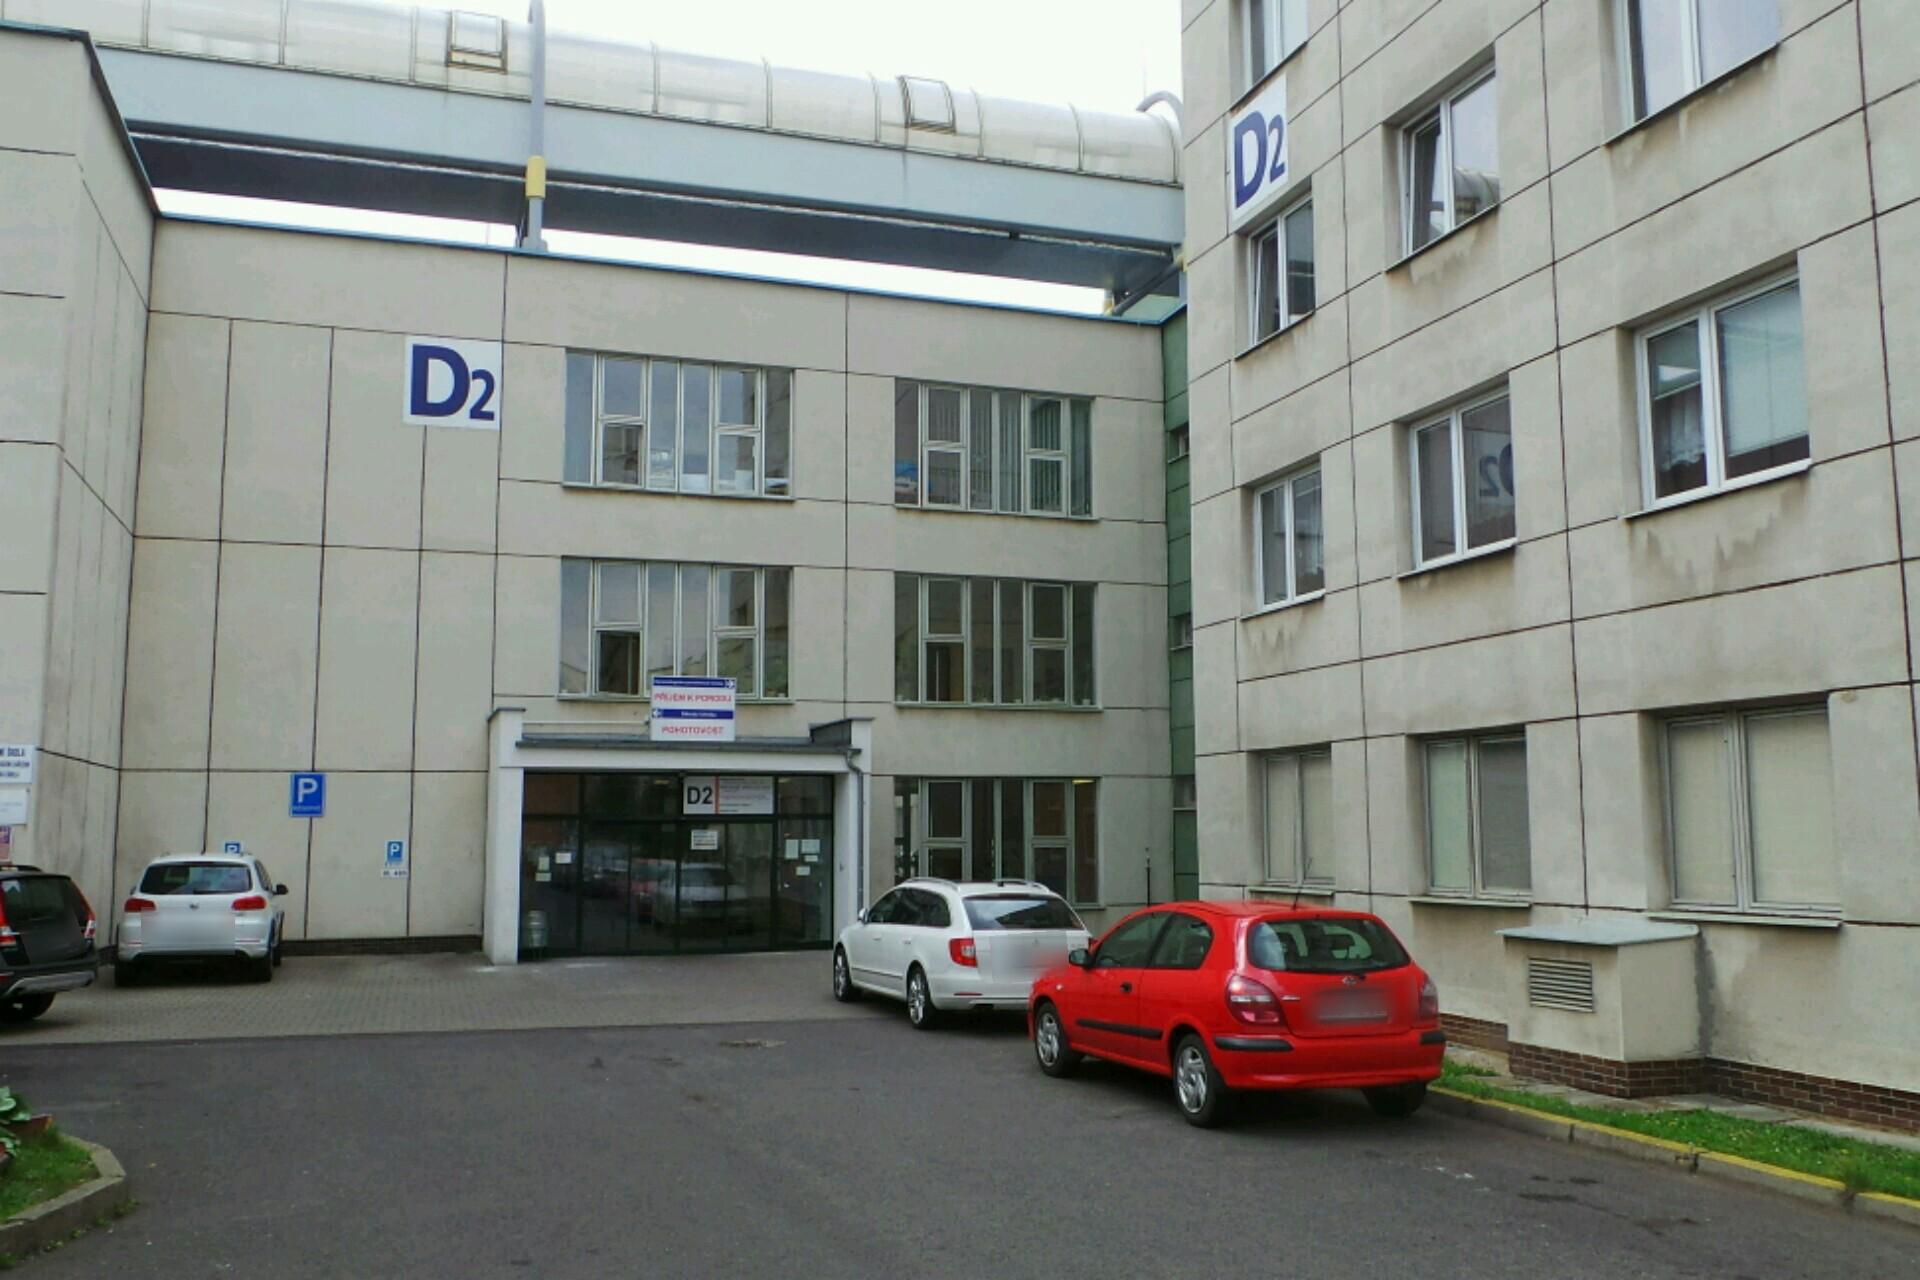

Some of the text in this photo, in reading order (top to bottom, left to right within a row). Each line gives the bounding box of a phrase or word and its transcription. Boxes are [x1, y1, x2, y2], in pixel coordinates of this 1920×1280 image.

[1234, 111, 1285, 209] D2
[410, 343, 495, 421] D2
[298, 778, 318, 802] P
[687, 786, 713, 804] D2
[390, 843, 400, 856] P
